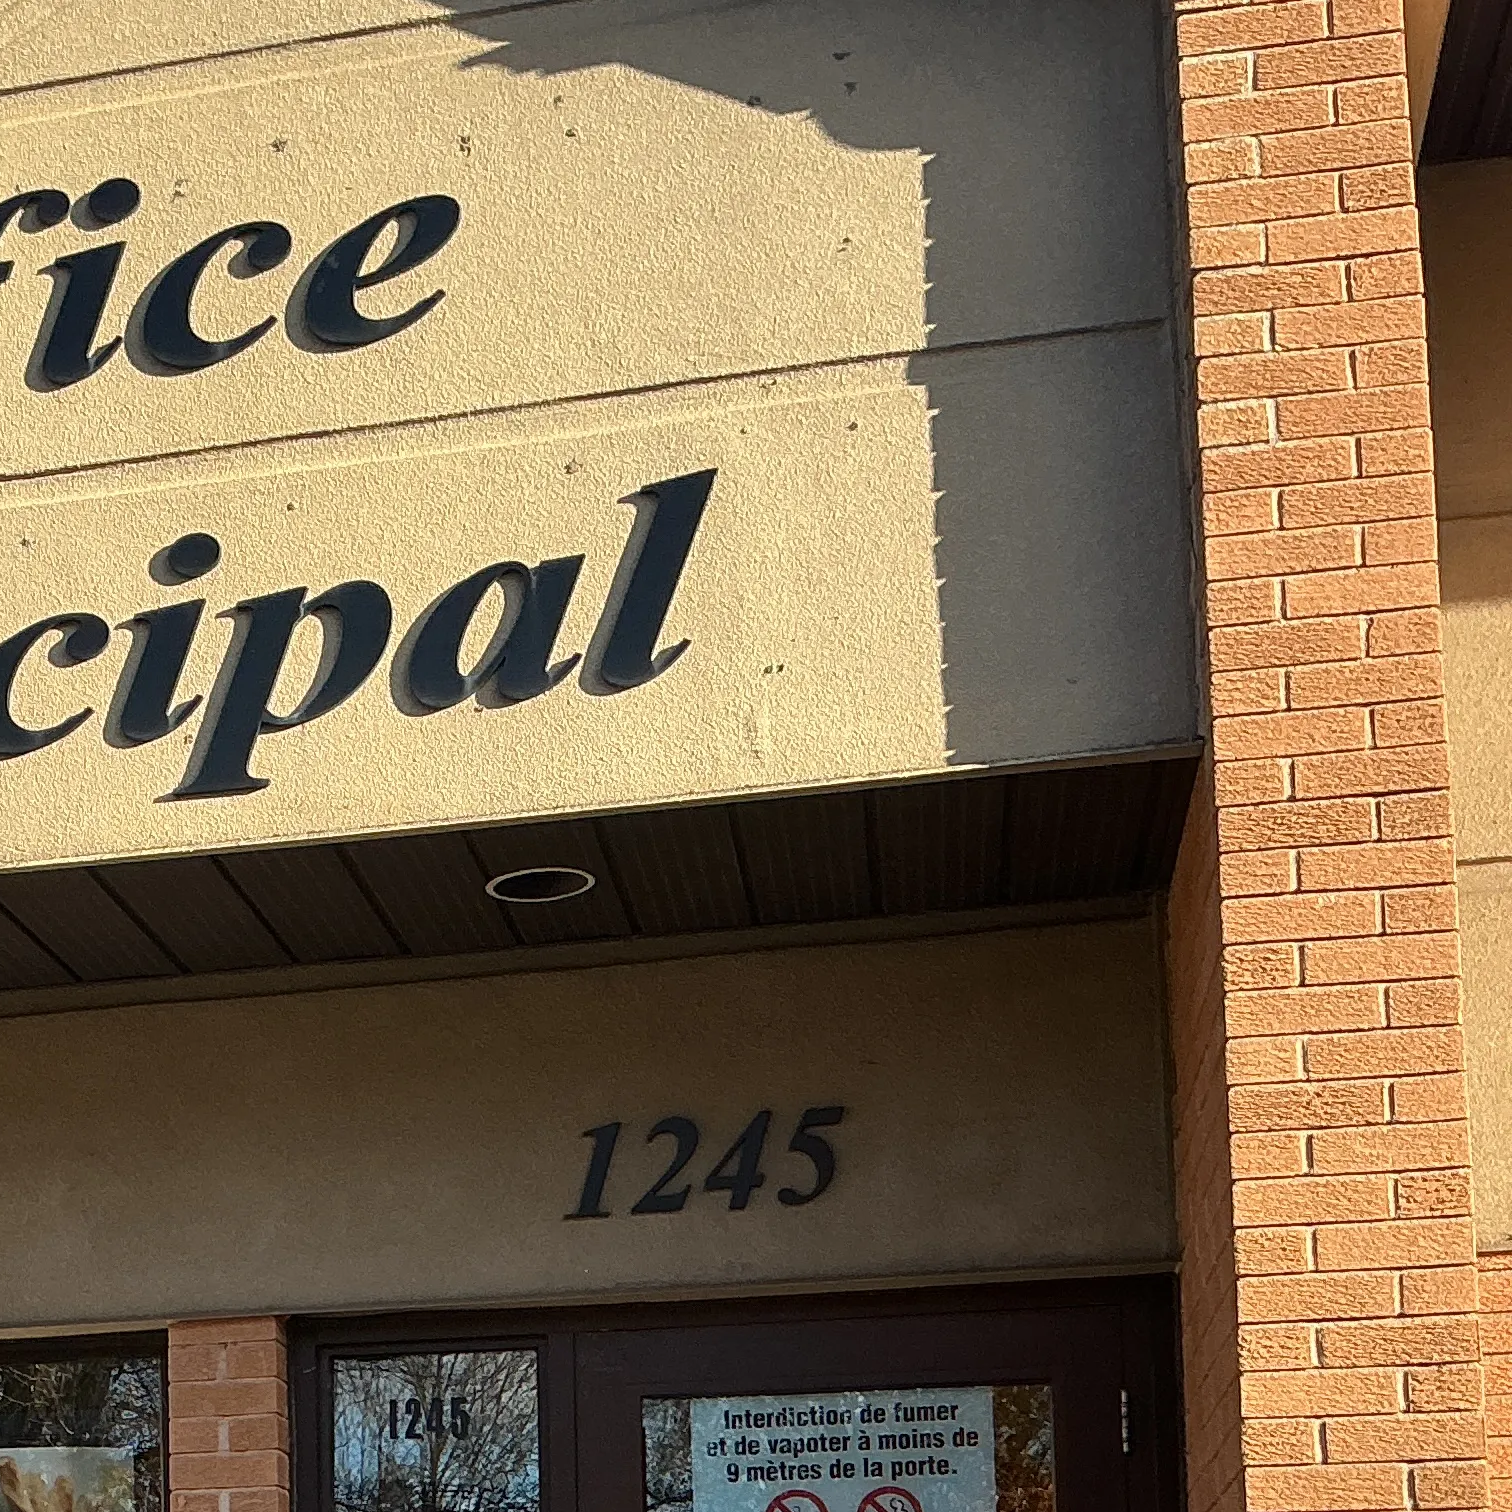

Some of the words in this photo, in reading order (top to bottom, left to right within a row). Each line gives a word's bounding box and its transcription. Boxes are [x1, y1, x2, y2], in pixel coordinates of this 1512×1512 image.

[562, 1105, 844, 1220] 1245
[389, 1397, 470, 1441] 1245
[724, 1404, 851, 1429] Interdiction
[860, 1404, 886, 1424] de
[894, 1402, 958, 1422] fumer
[707, 1438, 727, 1457] et
[735, 1435, 760, 1456] de
[768, 1433, 851, 1459] vapoter
[858, 1429, 870, 1451] à
[878, 1428, 945, 1450] moins
[953, 1427, 979, 1448] de
[727, 1463, 739, 1483] 9
[747, 1460, 822, 1482] mètres
[829, 1458, 855, 1479] de
[863, 1458, 883, 1478] la
[891, 1455, 958, 1481] porte.
